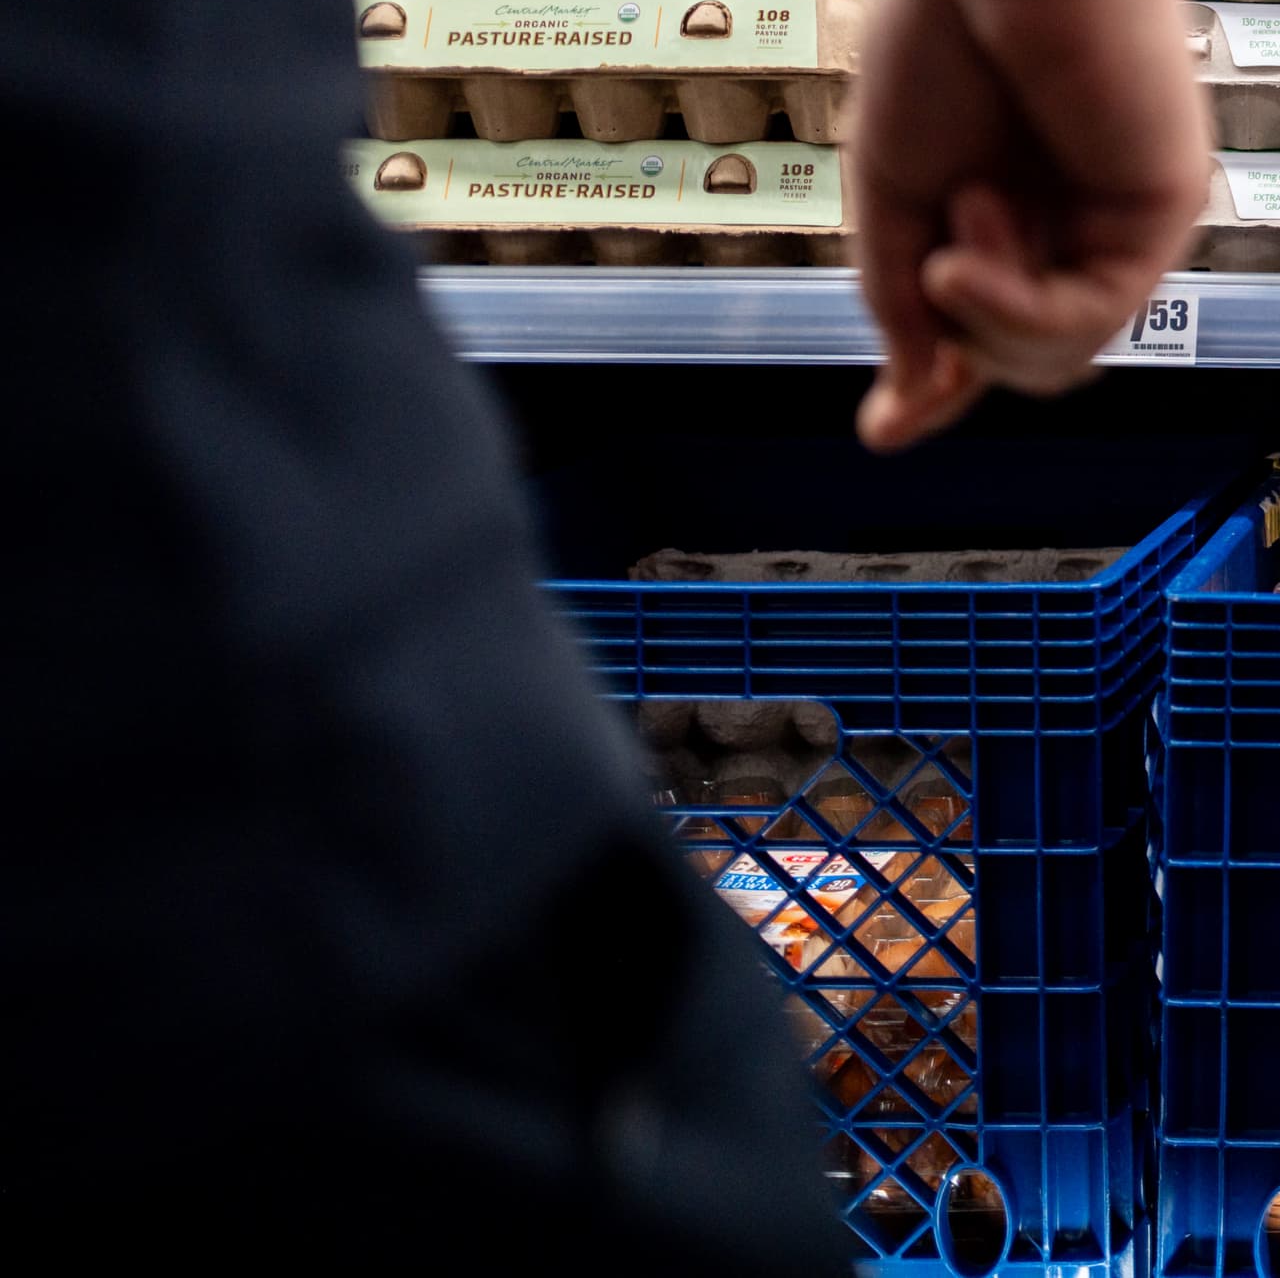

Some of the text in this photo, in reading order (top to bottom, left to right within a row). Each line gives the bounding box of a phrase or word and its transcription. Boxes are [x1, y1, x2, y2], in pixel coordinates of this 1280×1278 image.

[757, 9, 791, 22] 108
[515, 19, 570, 29] ORGANIC
[1242, 18, 1255, 27] 130
[1258, 20, 1271, 29] mg
[447, 31, 633, 47] PASTURE-RAISED
[1249, 41, 1278, 49] EXTRA
[781, 163, 815, 176] 108
[537, 172, 591, 181] ORGANIC
[468, 183, 656, 199] PASTURE-RAISED
